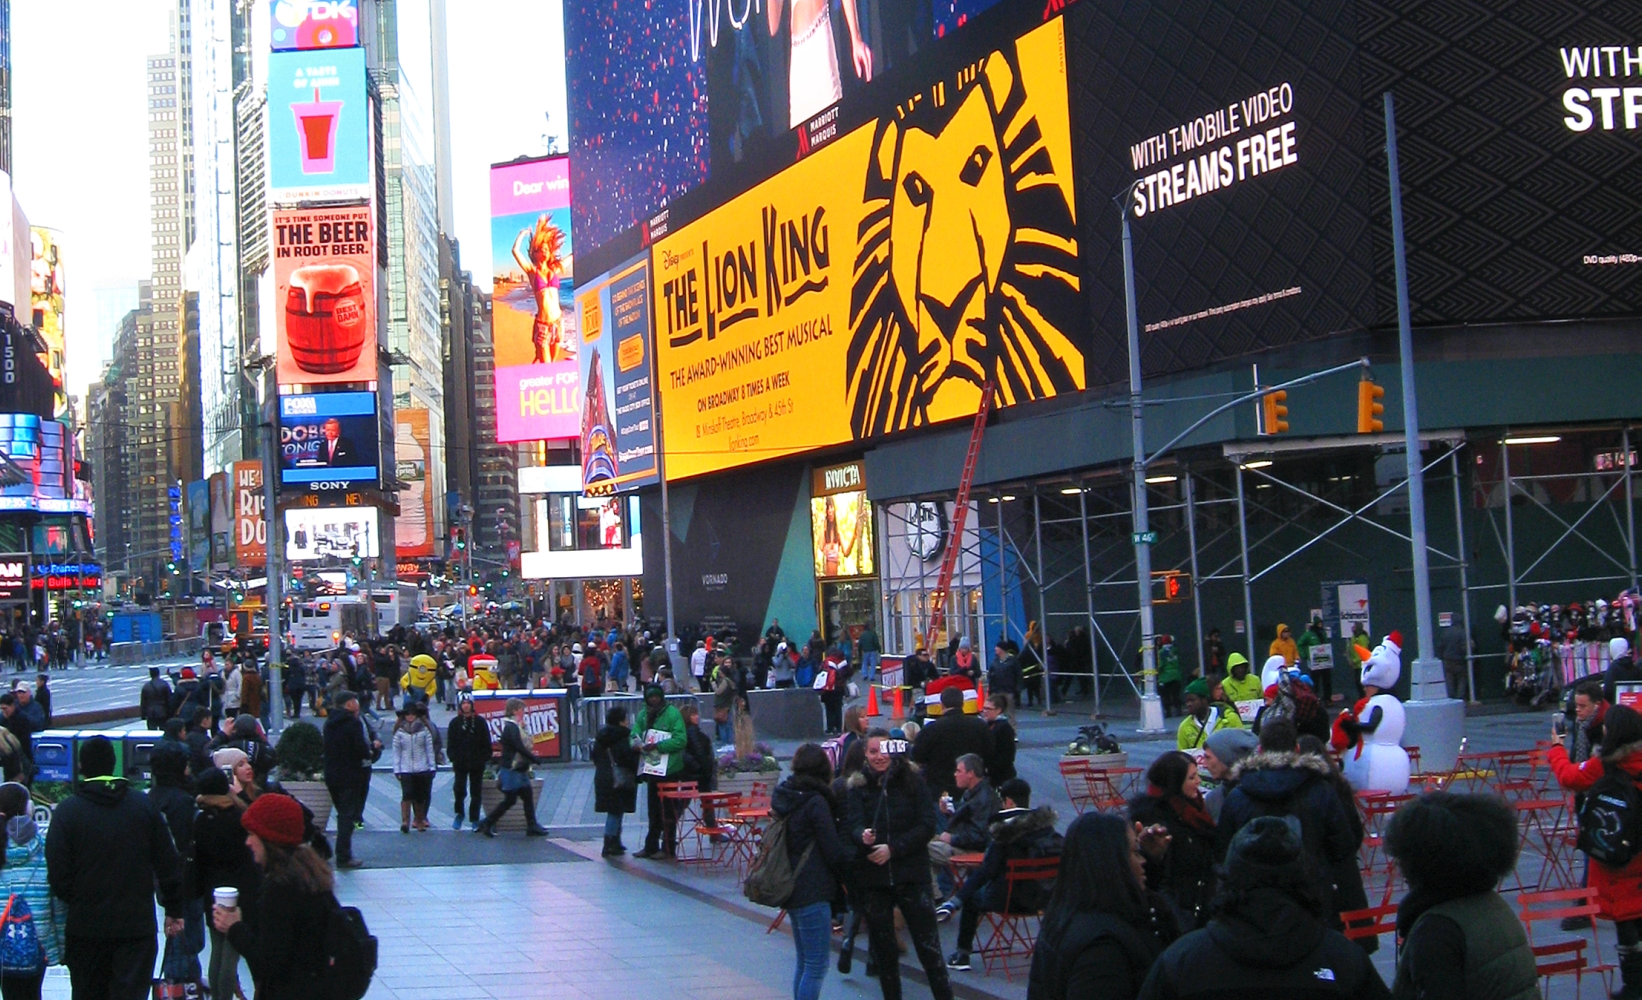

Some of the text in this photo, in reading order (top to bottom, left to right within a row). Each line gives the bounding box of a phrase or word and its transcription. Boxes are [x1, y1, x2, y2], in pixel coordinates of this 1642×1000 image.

[1560, 46, 1642, 78] WITH
[1131, 82, 1293, 171] WITH T-MOBILE VIDEO
[1133, 121, 1298, 218] STREAMS FREE
[513, 180, 543, 196] Dear
[276, 221, 368, 245] THE BEER
[277, 243, 369, 258] IN ROOT BEER.
[664, 267, 698, 335] THE
[703, 240, 758, 341] LION
[761, 203, 830, 318] KING
[5, 334, 15, 383] 1500
[670, 313, 833, 390] THE AWARD-WINNING BEST MUSICAL
[698, 371, 790, 412] ON BROADWAY 8 TIMES A WEEK
[729, 433, 759, 453] lionking.com
[310, 481, 350, 490] SONY
[825, 465, 860, 489] INVICTA
